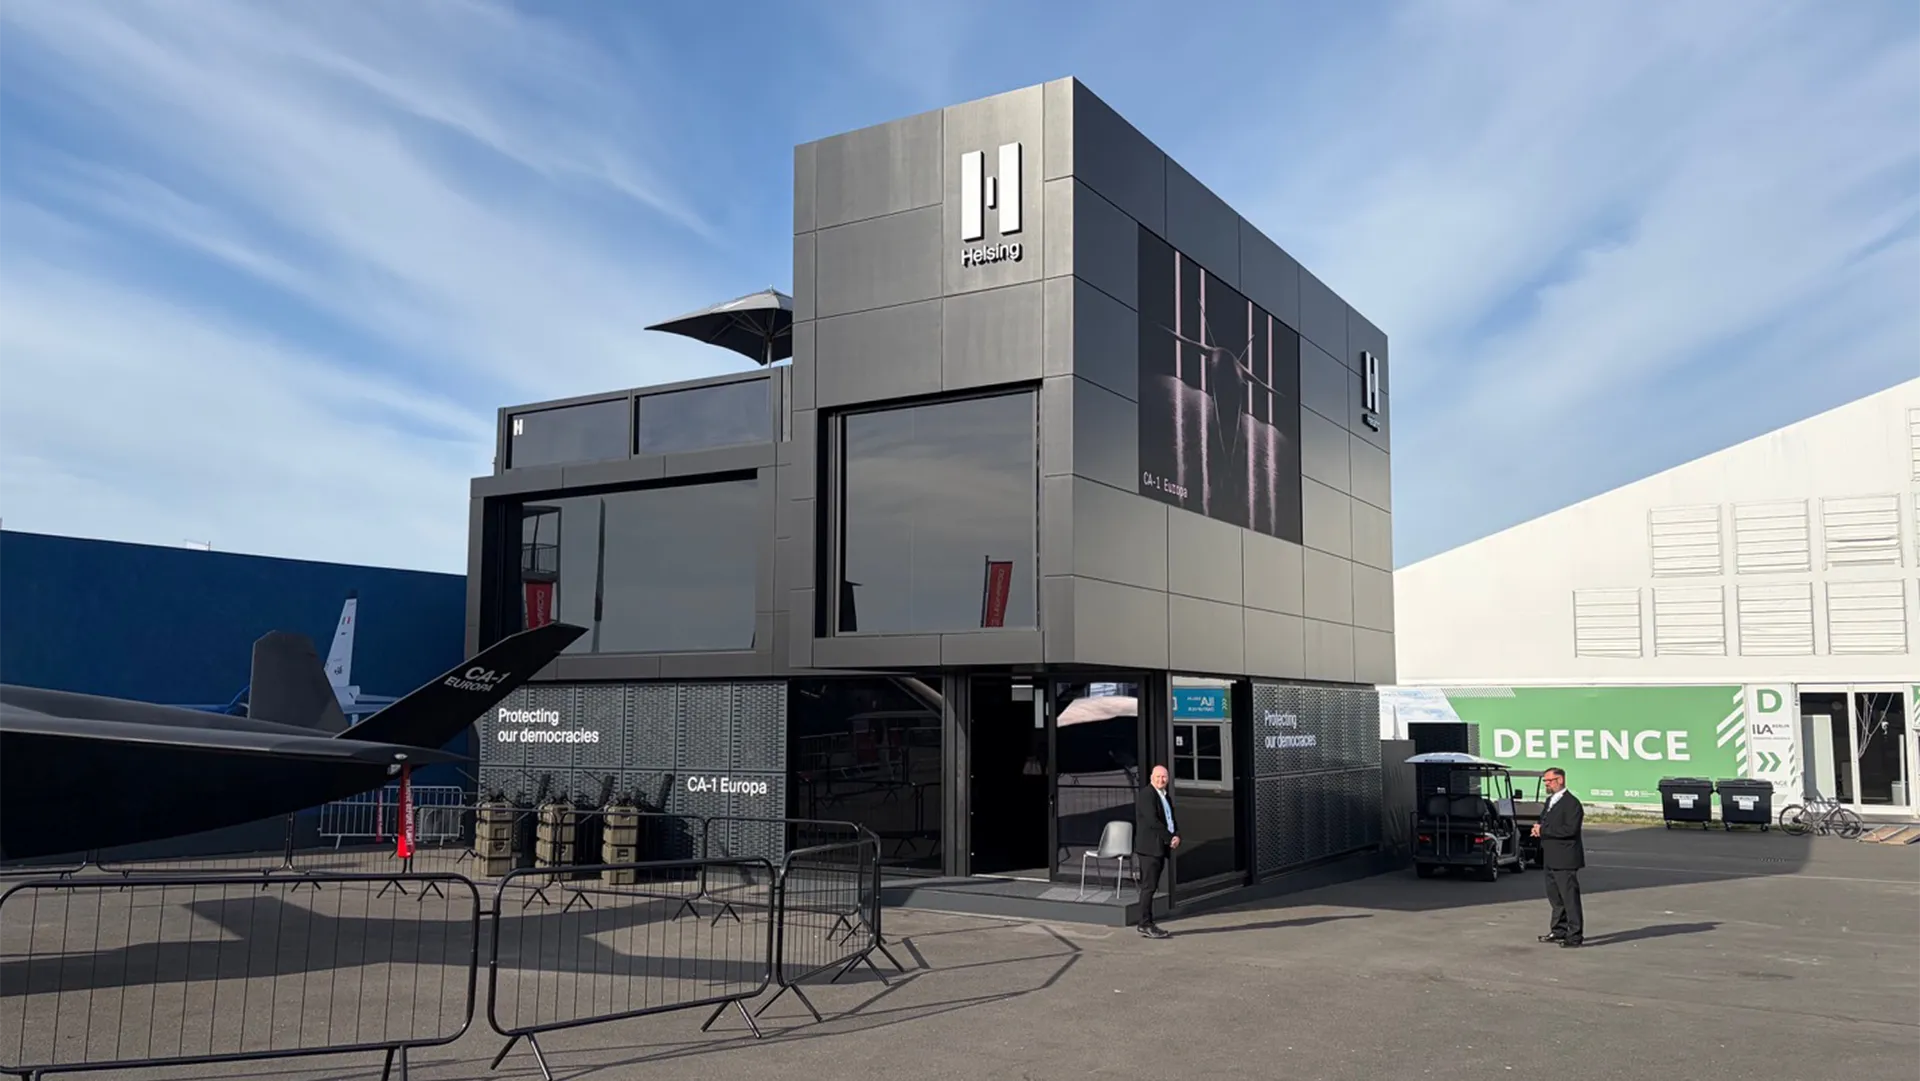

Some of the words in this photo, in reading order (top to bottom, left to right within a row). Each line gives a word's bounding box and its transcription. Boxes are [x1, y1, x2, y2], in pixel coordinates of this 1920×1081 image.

[961, 243, 1023, 268] Helsing
[1143, 471, 1160, 489] CA-1
[1164, 477, 1188, 499] Europa
[443, 676, 494, 692] EUROPA
[465, 667, 511, 684] CA-1
[1756, 688, 1783, 713] D
[498, 708, 559, 726] Protecting
[1264, 710, 1297, 730] Protecting
[498, 730, 518, 742] our
[519, 728, 599, 743] democracies
[1493, 728, 1691, 761] DEFENCE
[687, 776, 717, 792] CA-1
[720, 777, 767, 797] Europa
